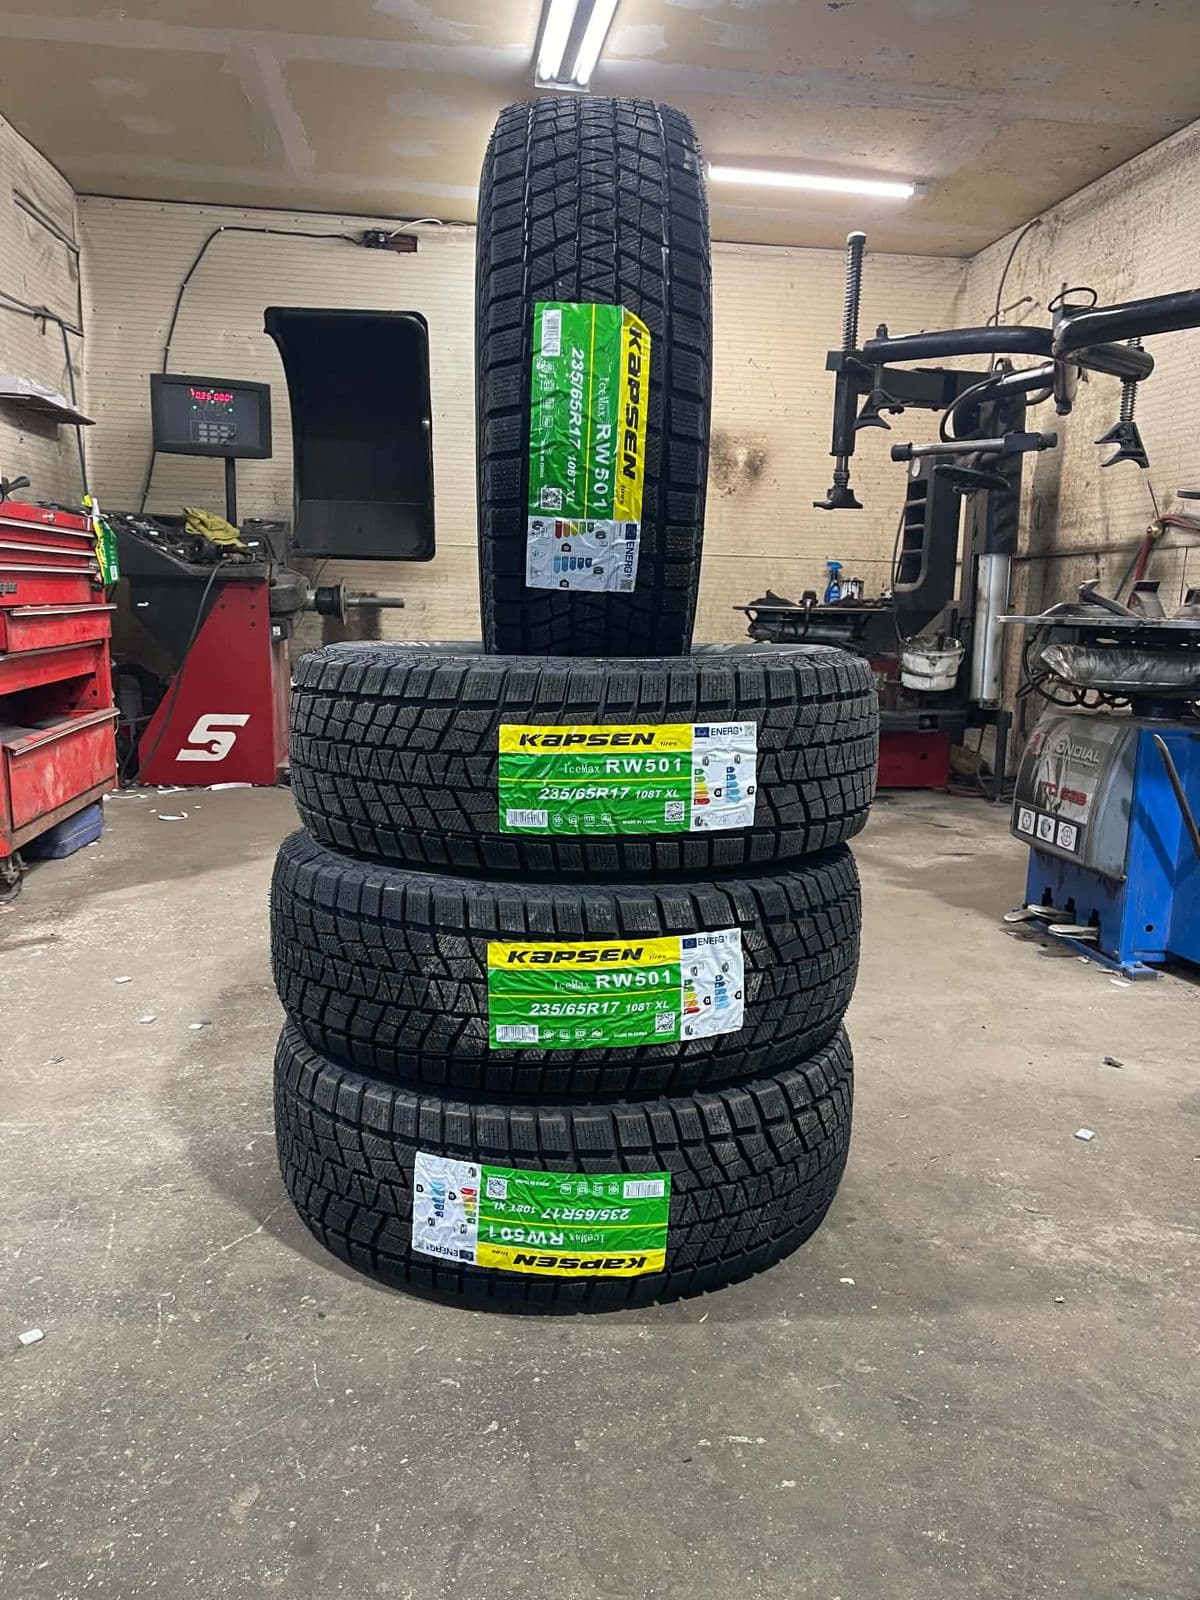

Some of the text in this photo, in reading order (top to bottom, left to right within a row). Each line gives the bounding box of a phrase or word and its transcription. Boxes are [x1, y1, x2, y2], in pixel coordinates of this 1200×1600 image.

[565, 347, 585, 504] 235/65R17 108T XL
[592, 423, 612, 508] RW501
[563, 757, 682, 774] IceMax RW501
[539, 787, 680, 801] 235/65R17 108T XL
[595, 971, 672, 989] RW501
[529, 1001, 671, 1016] 235/65R17 108T XL
[509, 1204, 537, 1214] 108T
[541, 1207, 632, 1221] 235/65R17
[488, 1224, 564, 1246] RW501
